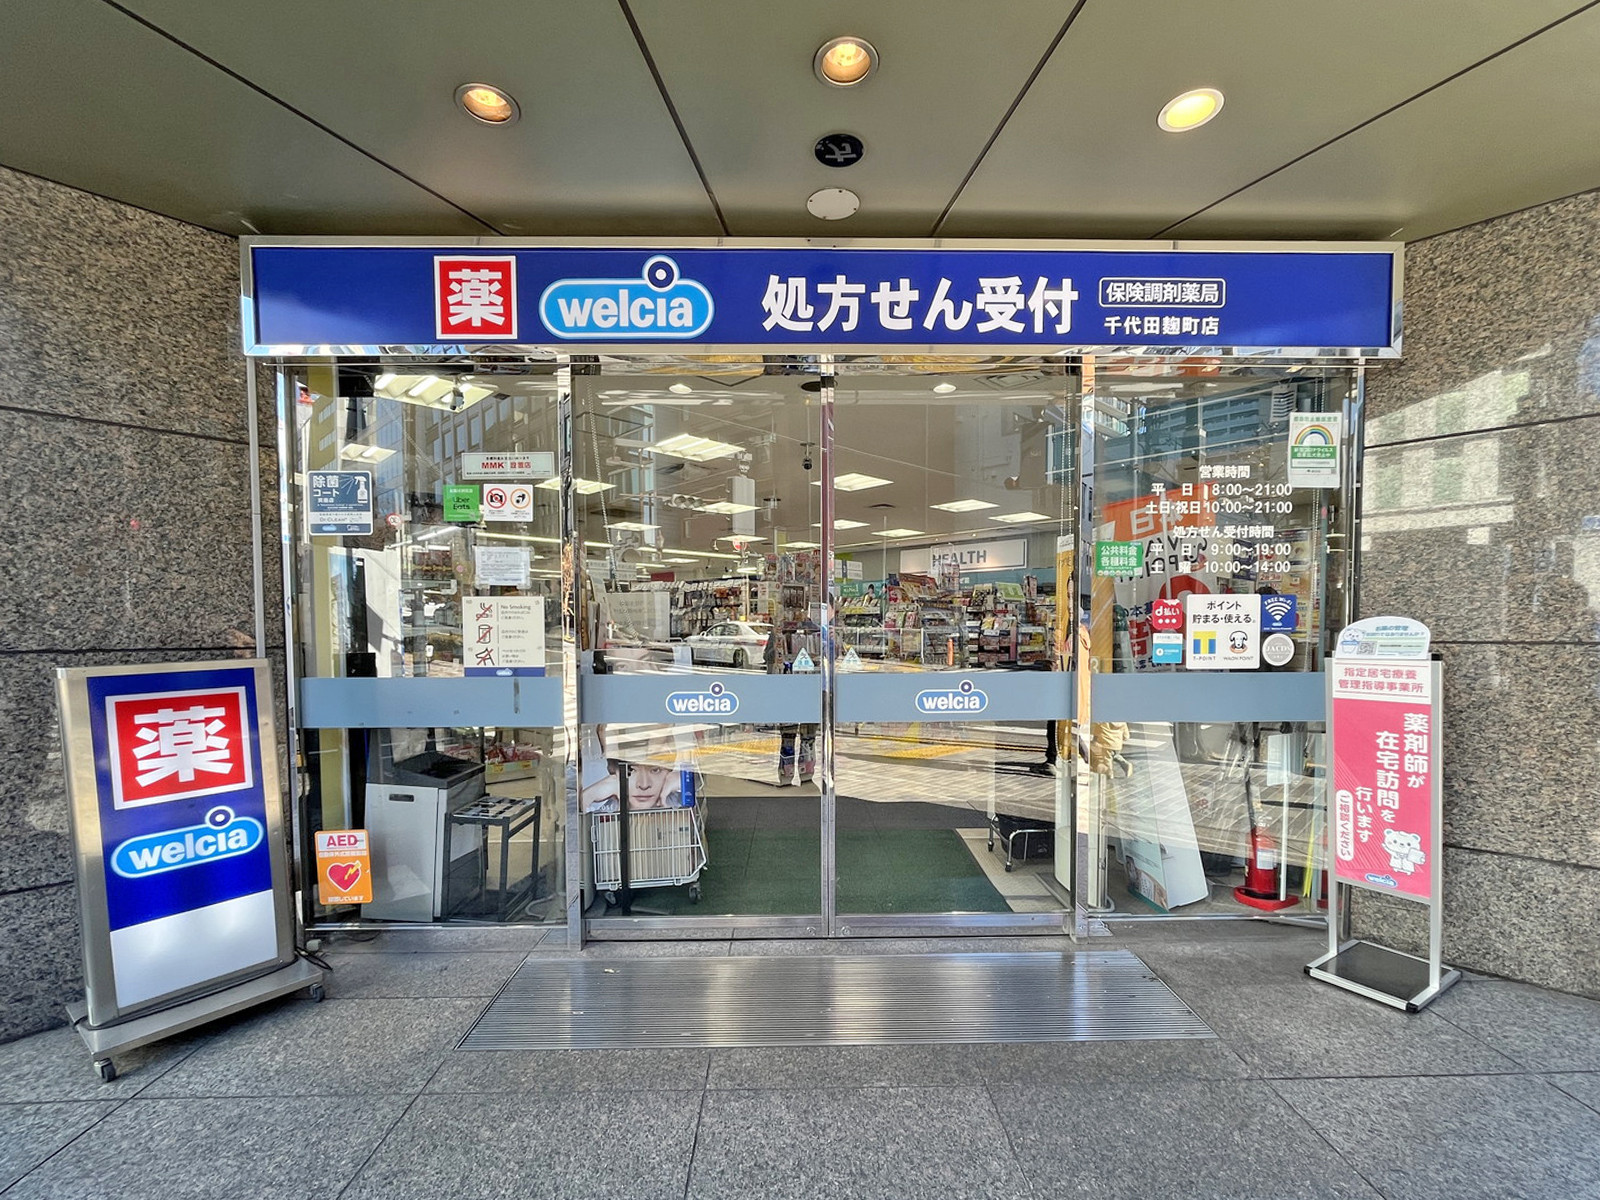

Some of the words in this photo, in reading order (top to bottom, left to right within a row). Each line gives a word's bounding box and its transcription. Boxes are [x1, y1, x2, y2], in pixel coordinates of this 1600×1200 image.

[447, 266, 506, 328] 薬
[557, 262, 694, 330] welcia
[761, 275, 1080, 334] 処方せん受付
[1105, 281, 1220, 305] 保険調剤薬局
[312, 475, 340, 488] 除菌
[1199, 465, 1251, 479] 営業時間
[312, 488, 340, 497] コート
[1172, 525, 1275, 539] 処方せん受付時間
[931, 549, 987, 567] HEALTH
[1100, 545, 1138, 556] 公共料金
[1100, 556, 1138, 566] 各種料金
[1206, 600, 1242, 611] ポイント
[673, 687, 731, 712] welcia
[923, 685, 980, 710] welcia
[132, 705, 234, 788] 薬
[1403, 712, 1429, 789] 薬剤師が
[1376, 731, 1400, 824] 在宅訪問を
[1355, 785, 1374, 843] 行います
[128, 813, 249, 871] welcia
[326, 834, 358, 847] AED
